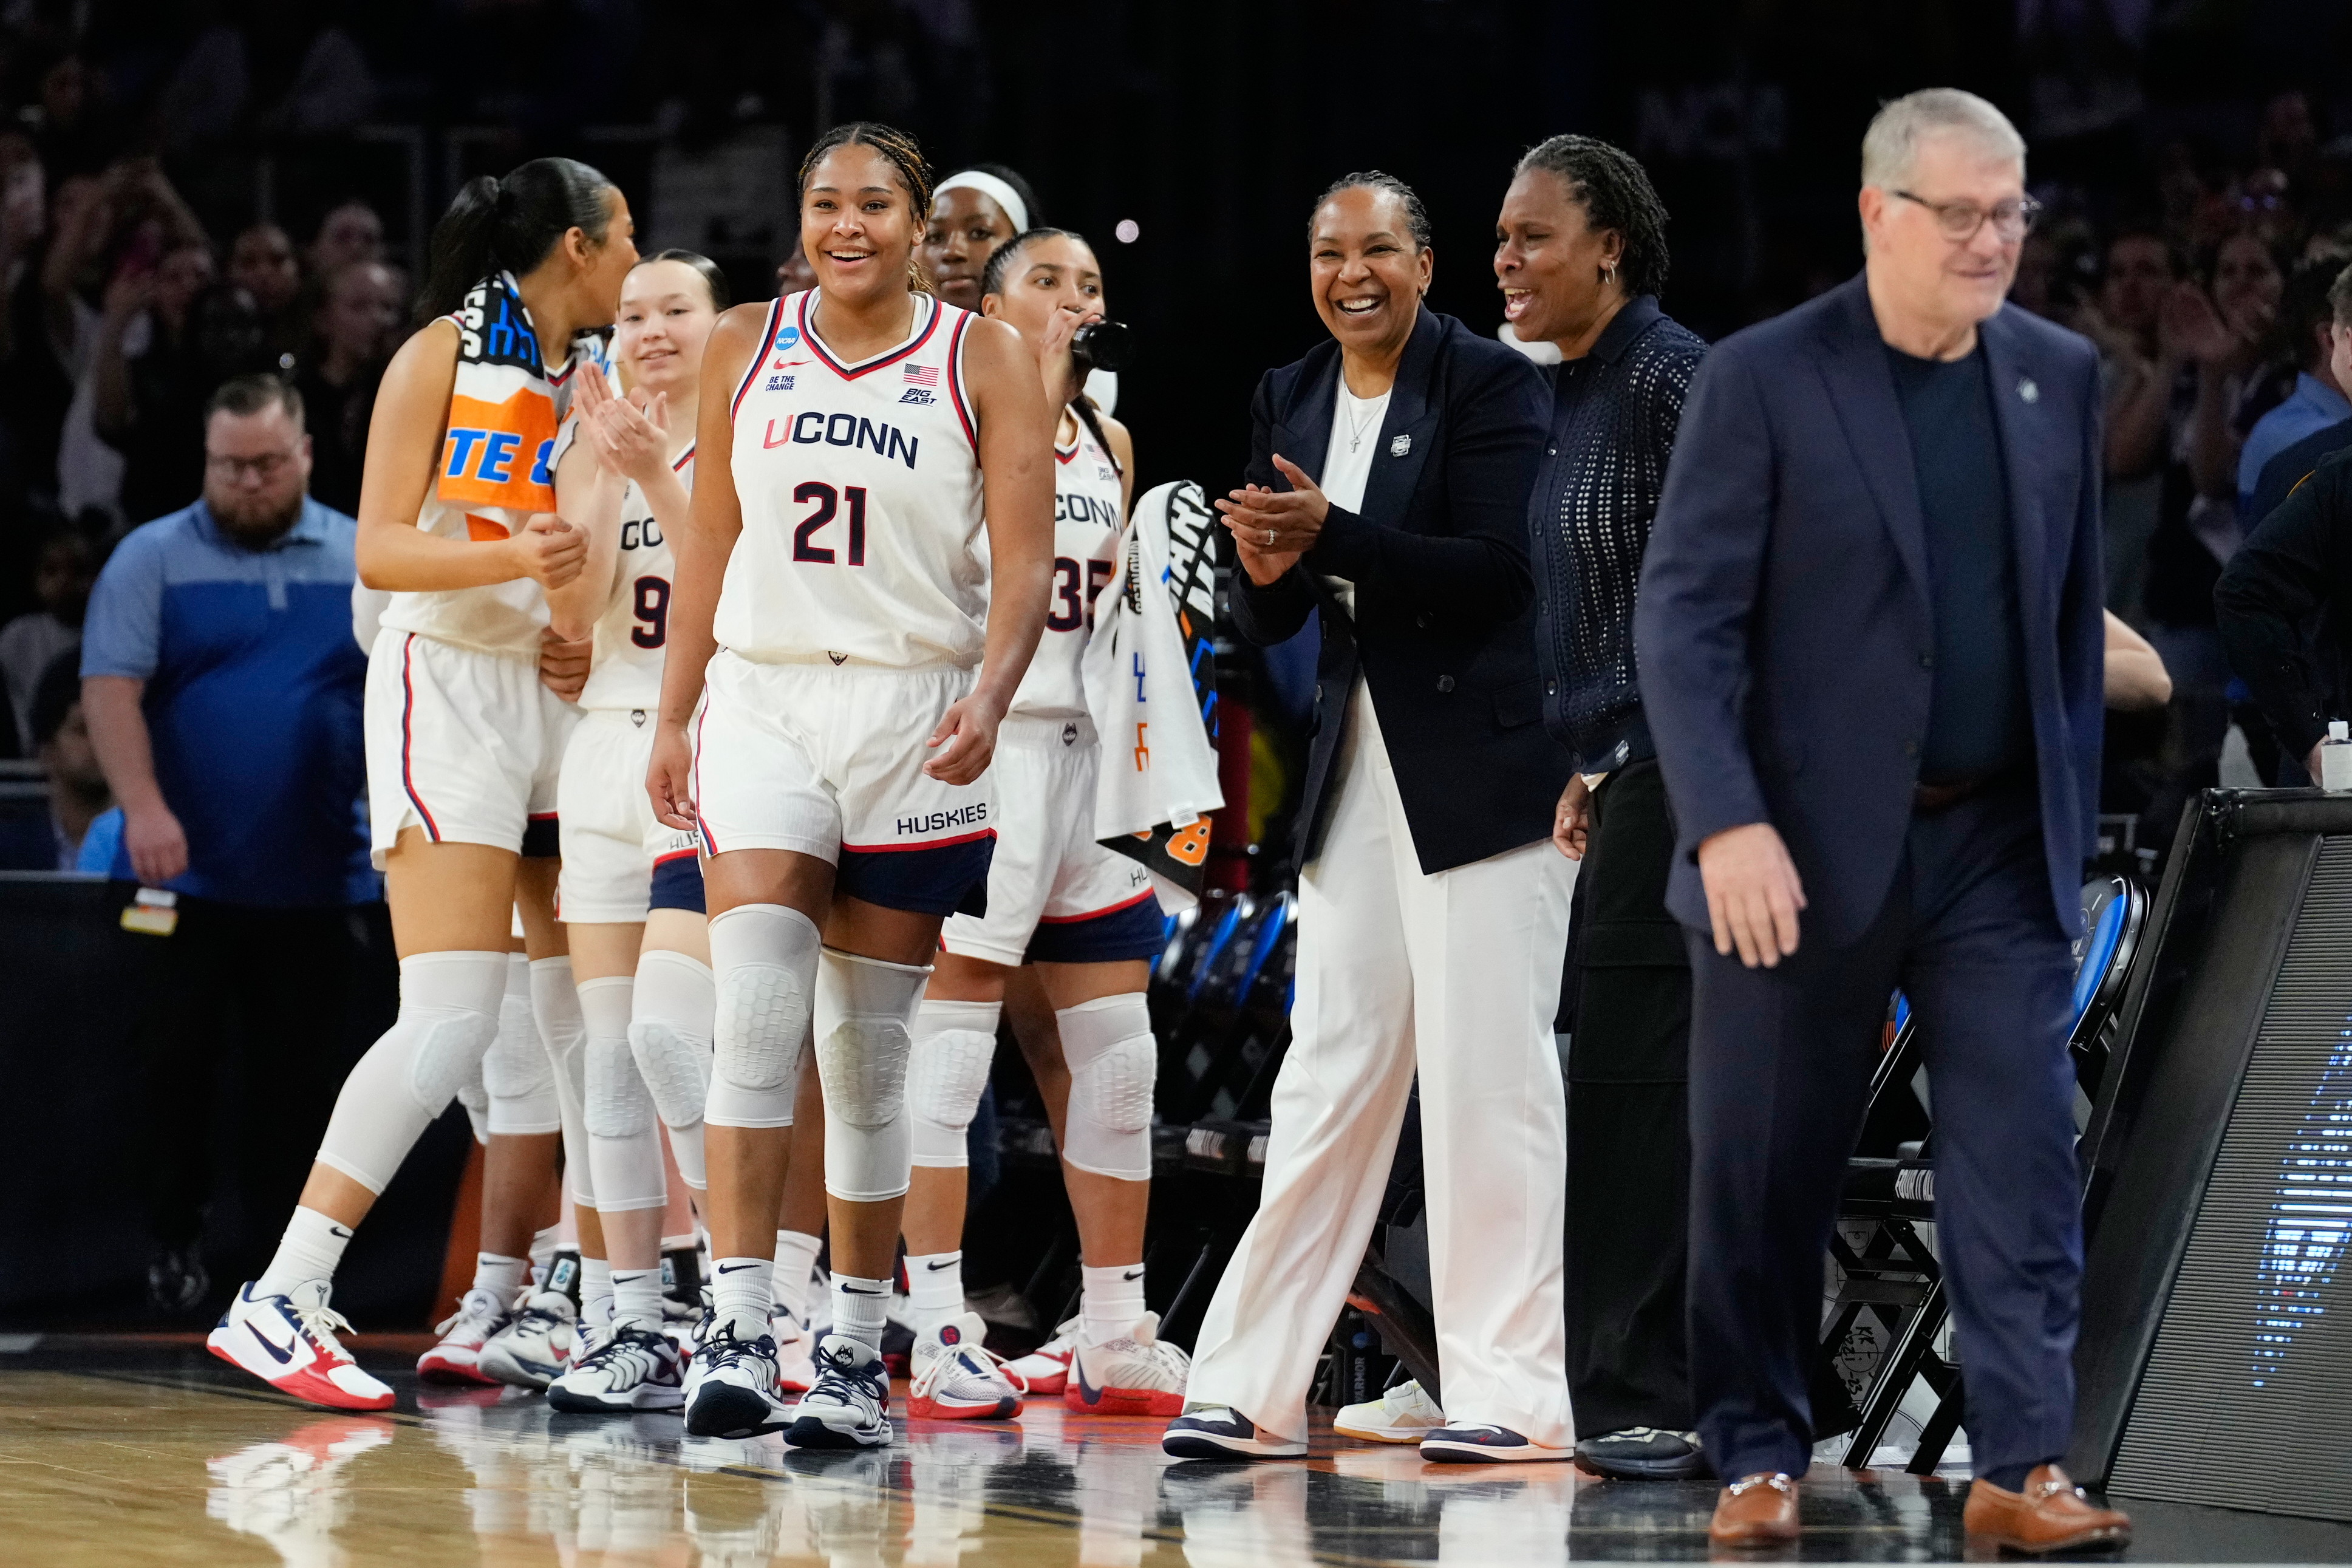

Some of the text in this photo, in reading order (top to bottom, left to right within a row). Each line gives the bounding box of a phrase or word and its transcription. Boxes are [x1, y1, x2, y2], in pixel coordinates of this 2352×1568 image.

[765, 383, 794, 392] CHANGE
[901, 394, 937, 404] EAST
[906, 388, 932, 397] BIG
[763, 412, 918, 470] UCONN
[793, 481, 867, 567] 21
[630, 575, 670, 649] 9
[1046, 556, 1113, 632] 35
[897, 803, 986, 835] HUSKIES
